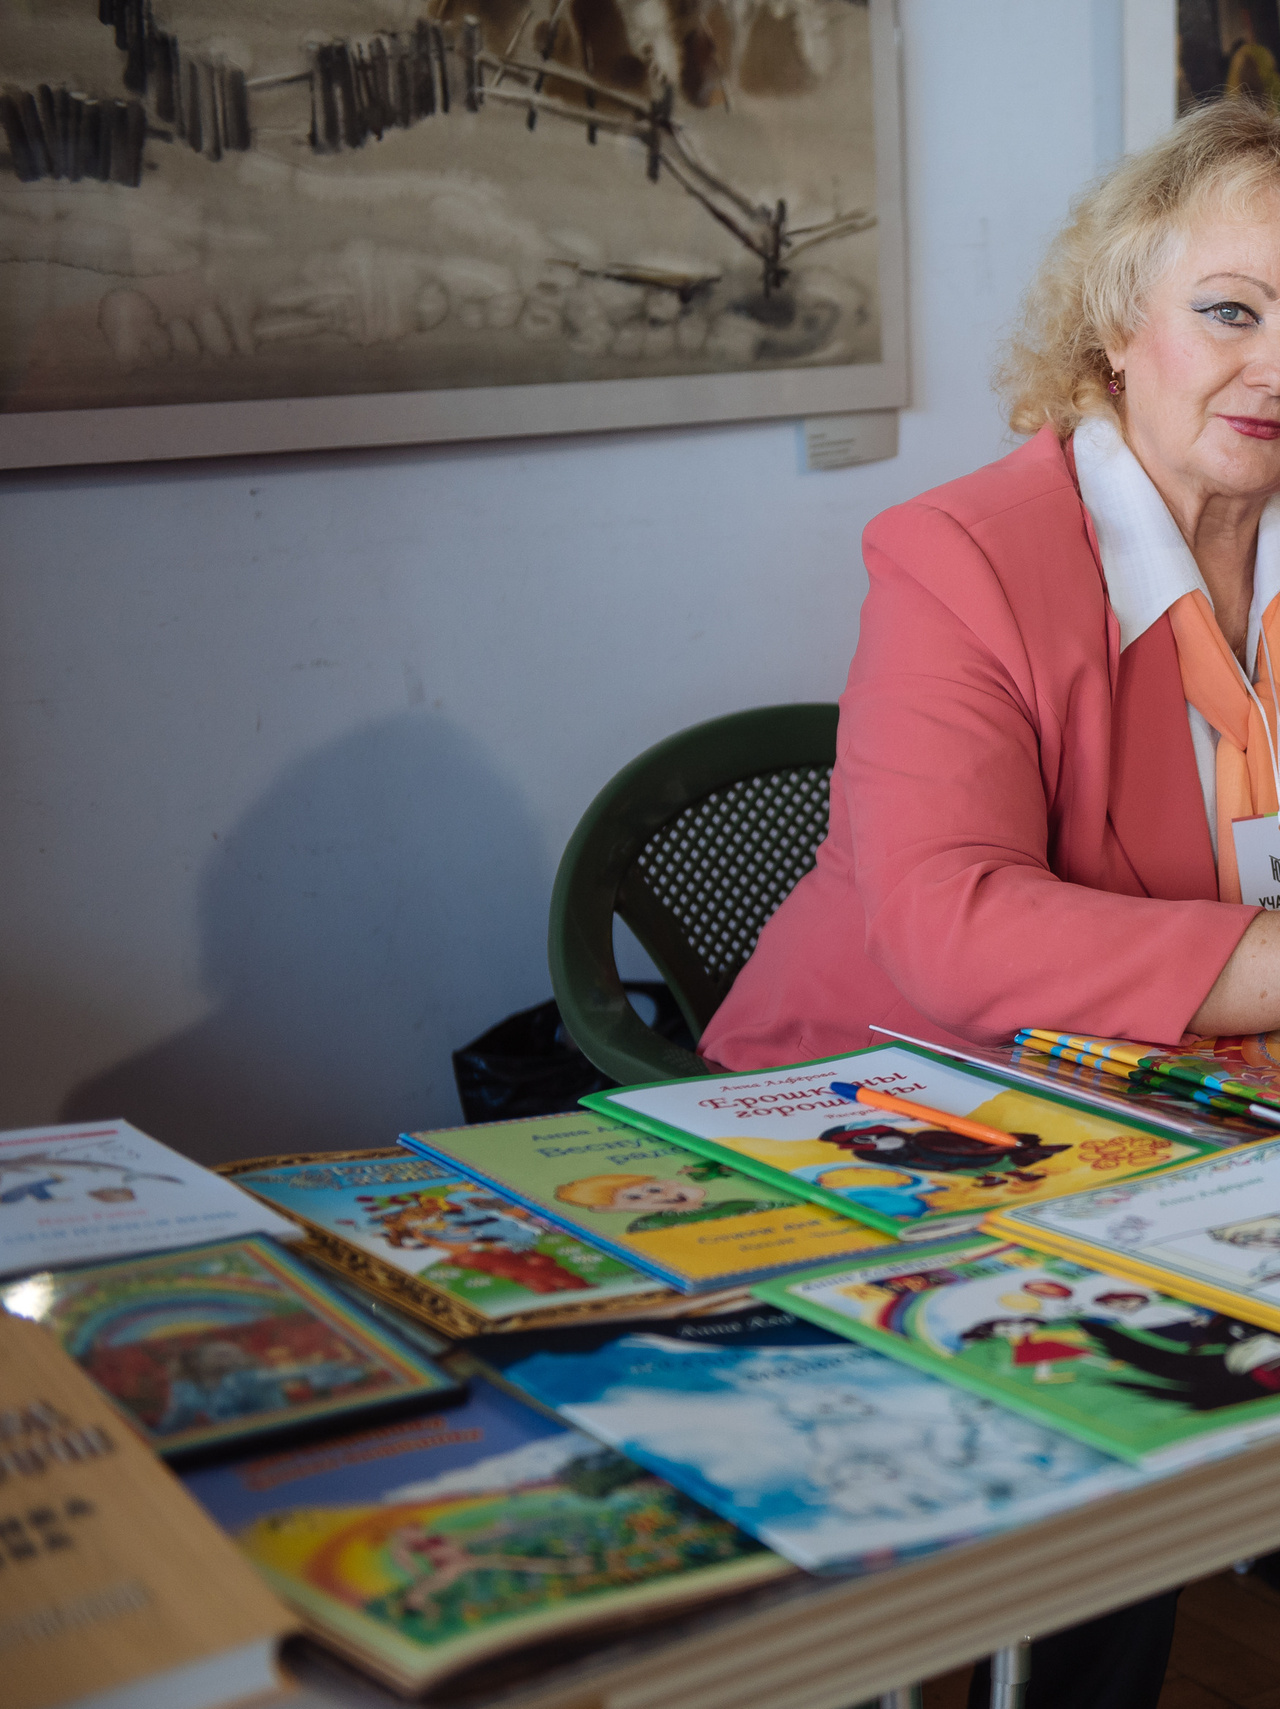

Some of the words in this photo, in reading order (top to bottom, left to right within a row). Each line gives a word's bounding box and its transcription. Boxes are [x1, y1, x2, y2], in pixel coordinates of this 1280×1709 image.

[698, 1072, 907, 1109] Ерошкны
[720, 1083, 761, 1092] Анна
[735, 1083, 927, 1118] горошы
